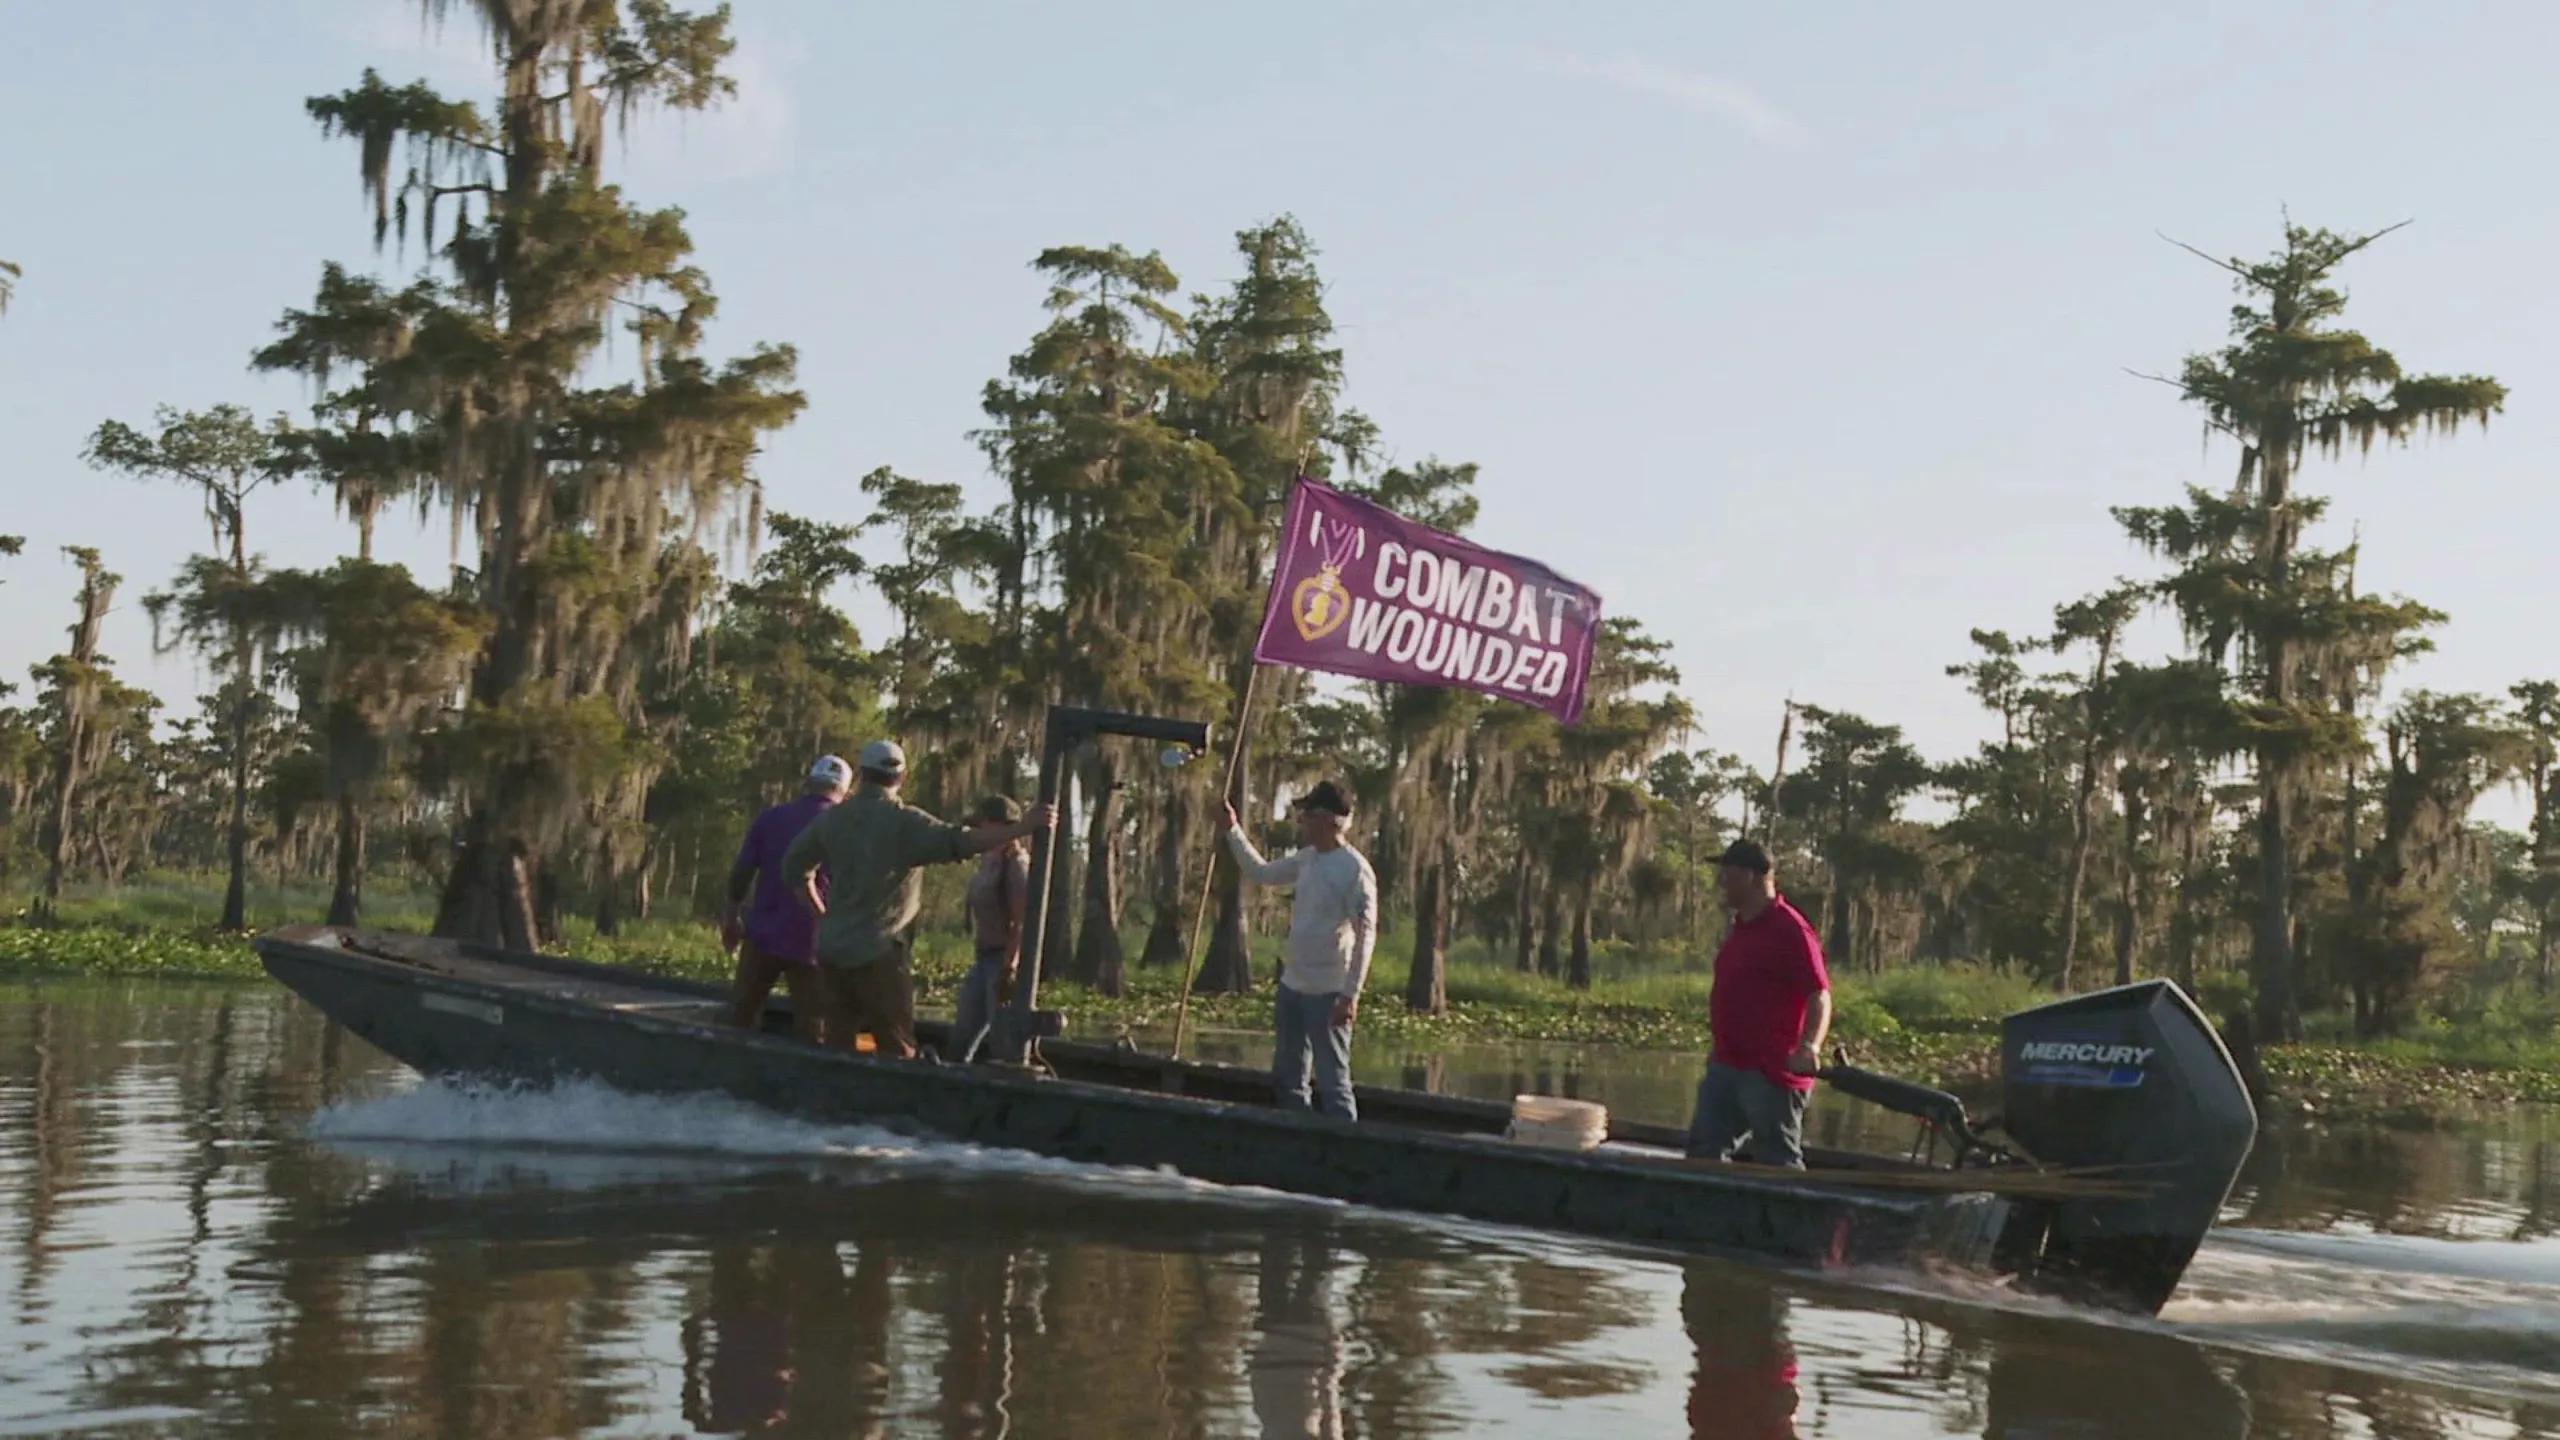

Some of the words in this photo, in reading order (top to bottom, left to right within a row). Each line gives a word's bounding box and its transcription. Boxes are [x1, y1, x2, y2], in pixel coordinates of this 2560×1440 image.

[1374, 542, 1575, 645] COMBAT
[1348, 598, 1568, 696] WOUNDED
[2022, 1043, 2153, 1064] MERCURY
